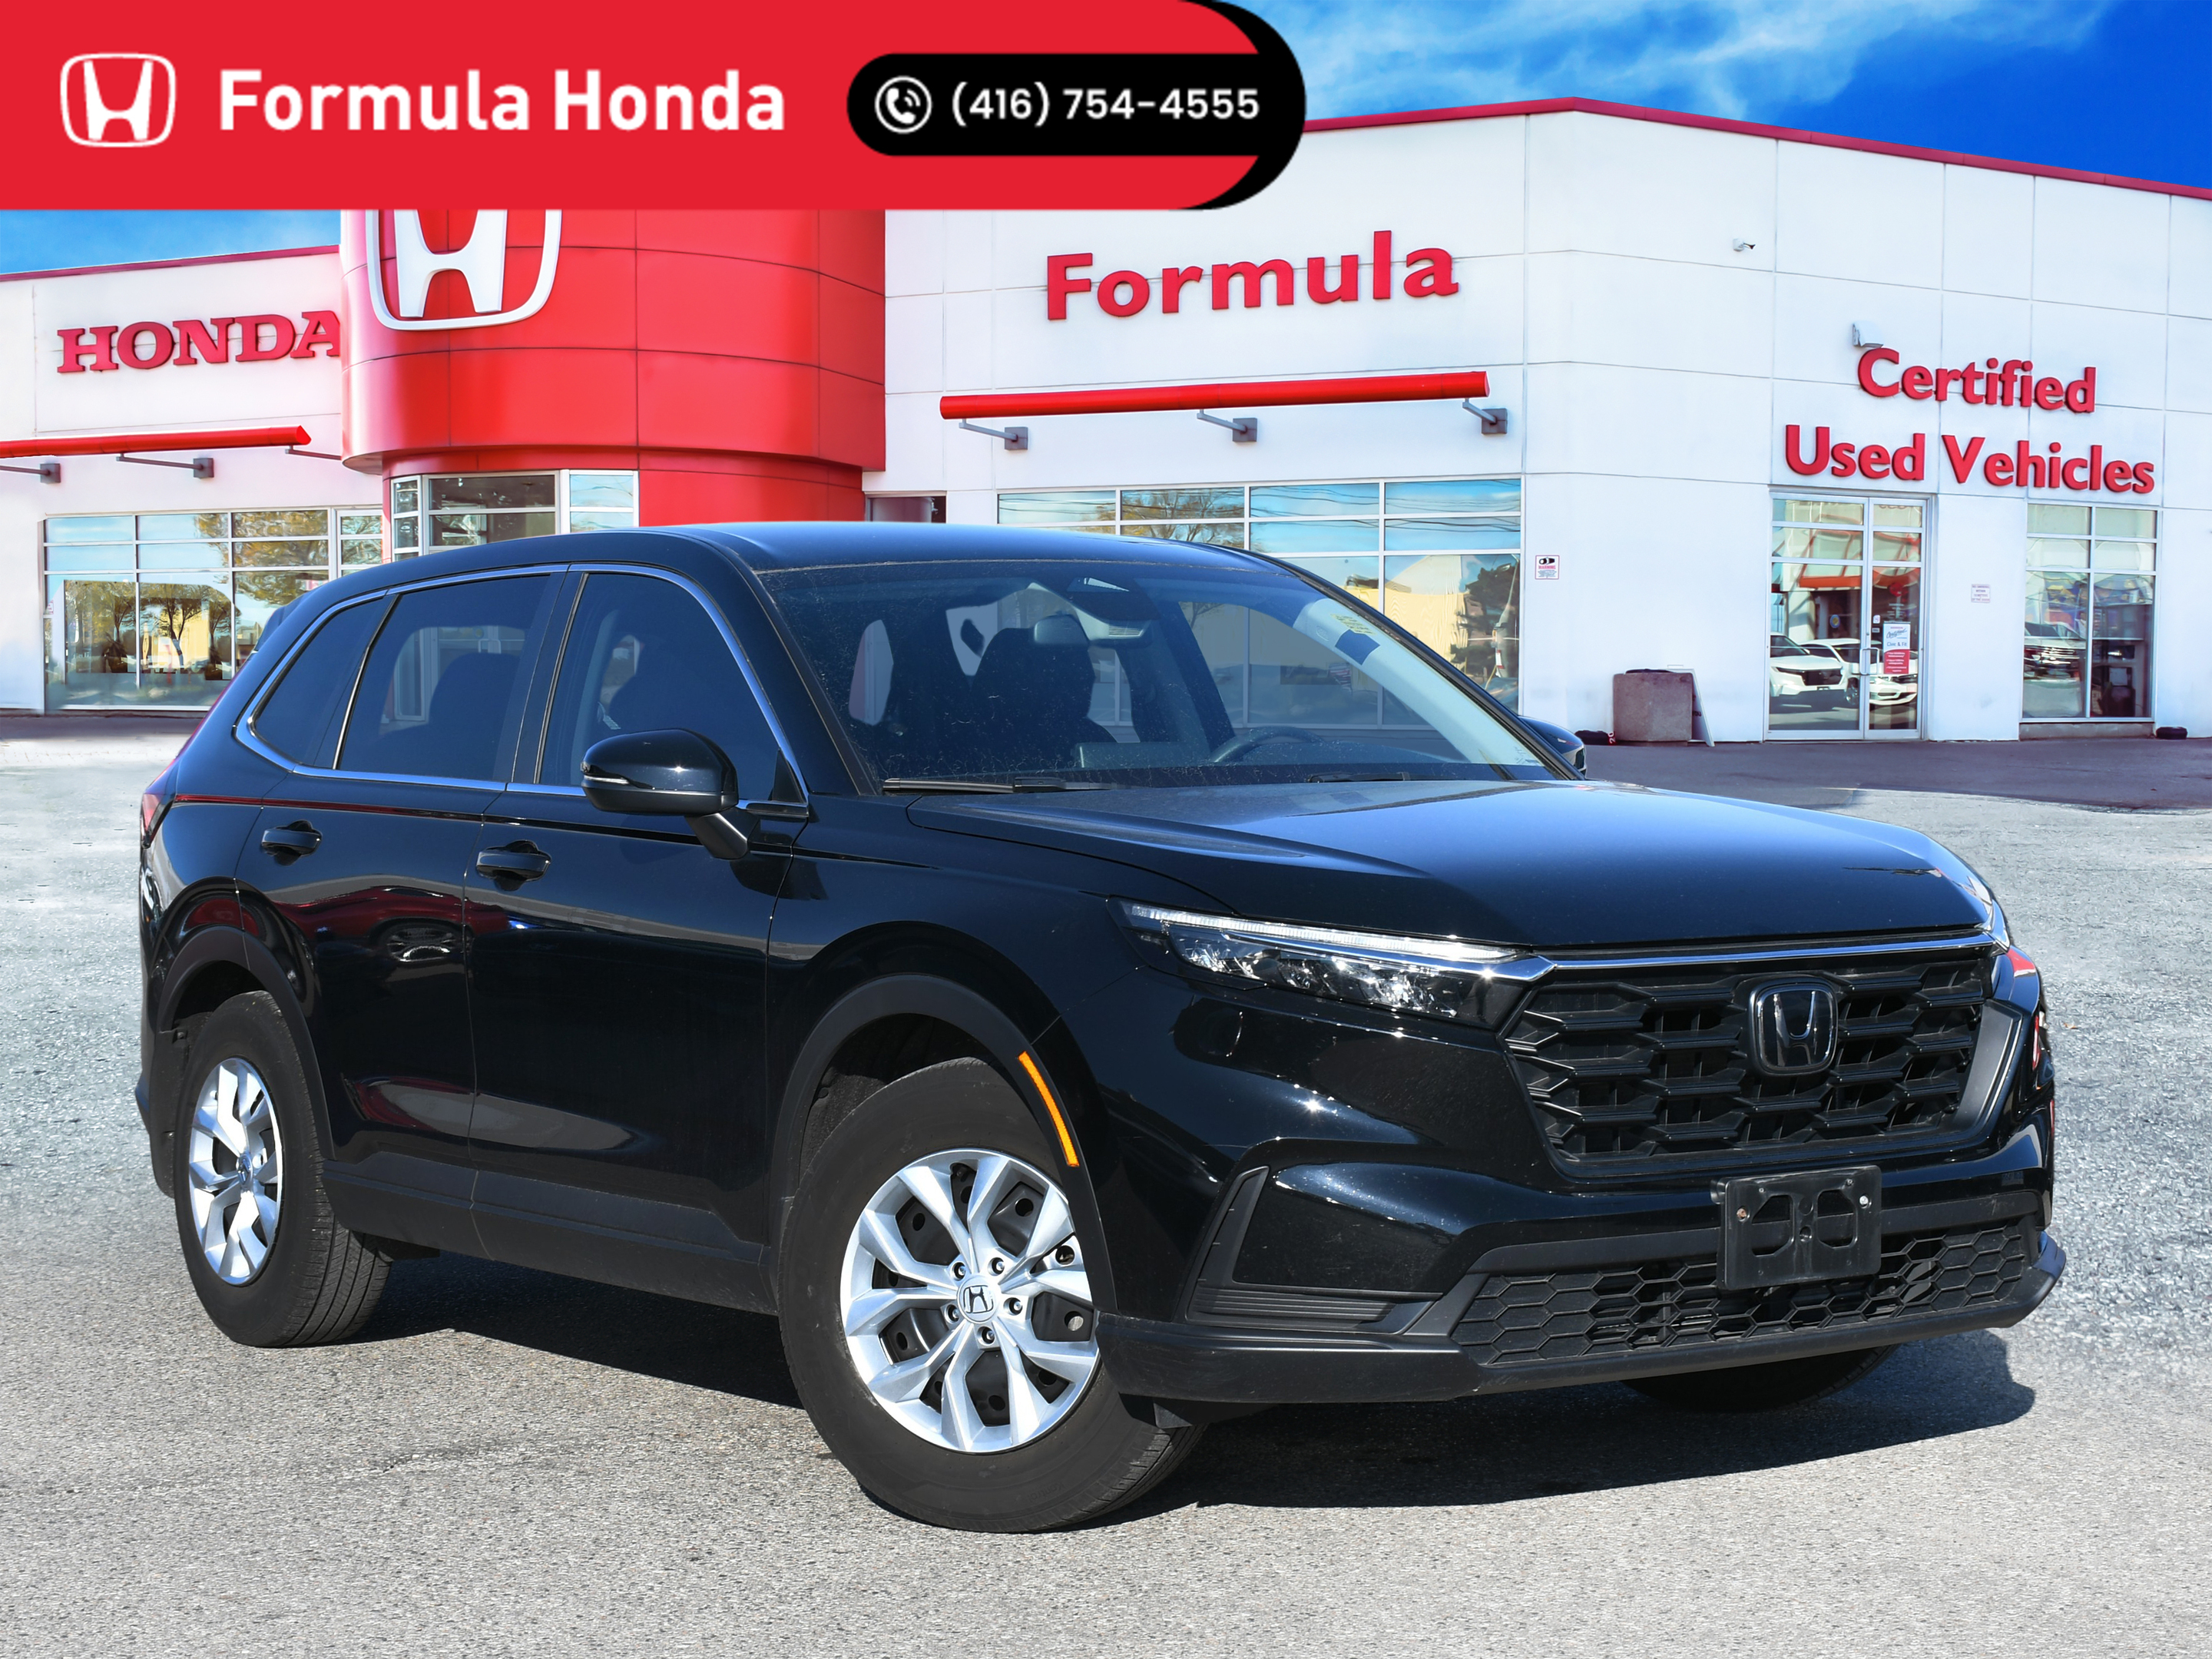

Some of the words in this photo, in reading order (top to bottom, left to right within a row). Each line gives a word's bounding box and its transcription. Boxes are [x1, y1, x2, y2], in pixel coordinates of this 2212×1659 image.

[1047, 230, 1459, 320] Formula
[57, 310, 340, 373] HONDA
[1858, 348, 2097, 413] Certified
[1786, 424, 1926, 481] Used
[1942, 435, 2155, 494] Vehicles
